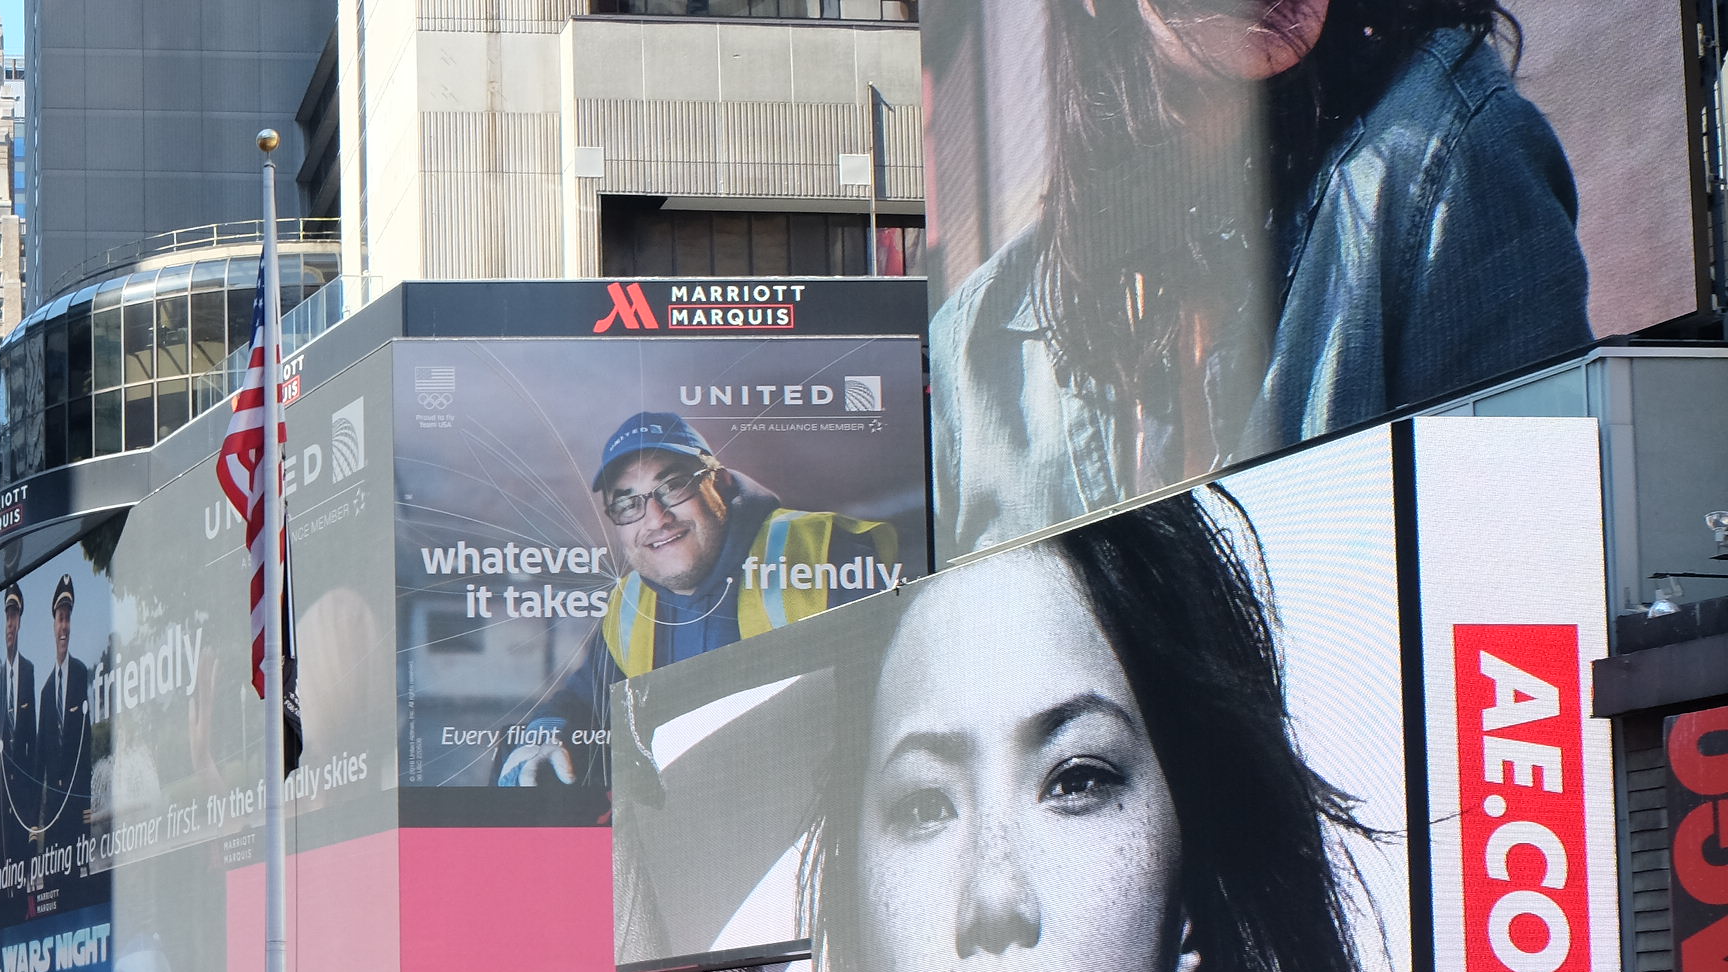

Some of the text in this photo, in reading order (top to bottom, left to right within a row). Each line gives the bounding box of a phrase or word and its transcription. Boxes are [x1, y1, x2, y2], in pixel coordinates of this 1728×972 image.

[670, 285, 805, 303] MARRIOTT
[671, 307, 791, 327] MARQUIS
[680, 385, 834, 406] UNITED
[421, 541, 607, 575] whatever
[466, 585, 609, 619] it takes
[93, 623, 203, 724] friendly
[441, 725, 564, 748] Every flight,
[31, 844, 72, 885] putting
[77, 833, 96, 864] the
[100, 816, 162, 859] customer
[167, 800, 200, 839] first.
[207, 796, 226, 827] fly
[230, 785, 253, 817] the
[323, 751, 367, 790] skies
[55, 923, 111, 970] NIGHT
